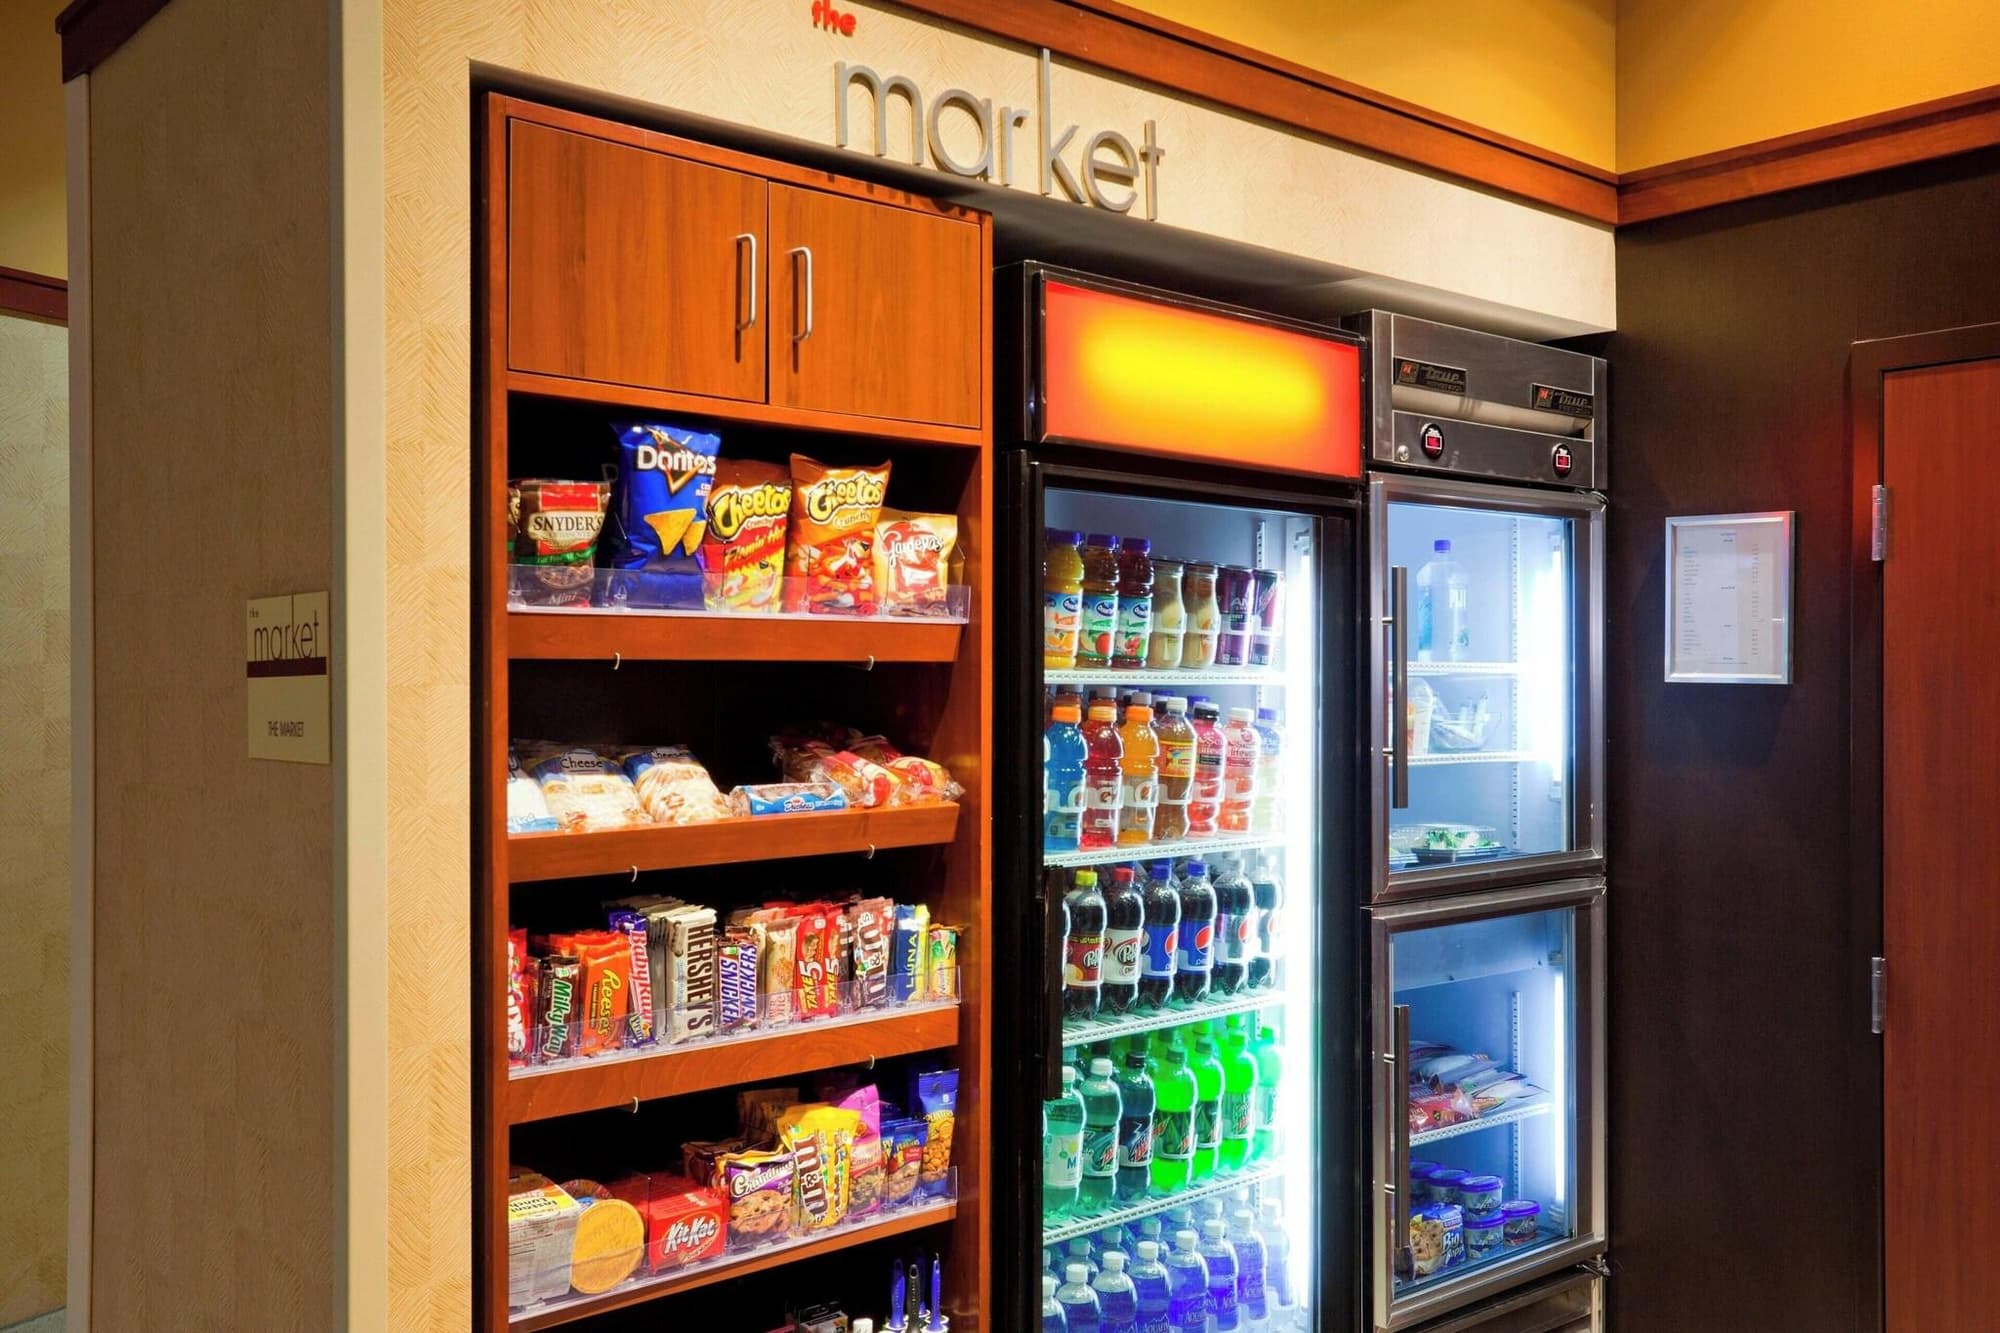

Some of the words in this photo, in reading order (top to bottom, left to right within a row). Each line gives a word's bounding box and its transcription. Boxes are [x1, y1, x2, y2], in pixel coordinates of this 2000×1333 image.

[812, 0, 857, 36] the
[833, 48, 1165, 221] market
[637, 445, 717, 475] Doritos
[713, 483, 791, 539] Cheetos
[808, 474, 883, 522] Cheetos
[533, 515, 602, 532] SNYDER'S
[253, 594, 320, 661] market
[267, 720, 279, 737] THE
[279, 720, 304, 738] MARKET
[560, 756, 604, 768] Cheese
[630, 930, 650, 983] Baby
[687, 923, 713, 1031] HERSHEY'S
[798, 960, 823, 982] 5
[905, 934, 918, 989] LUNA
[546, 979, 572, 1024] Milky
[598, 968, 621, 1035] Reese's
[739, 943, 757, 1020] SNICKERS
[544, 1022, 569, 1055] Way
